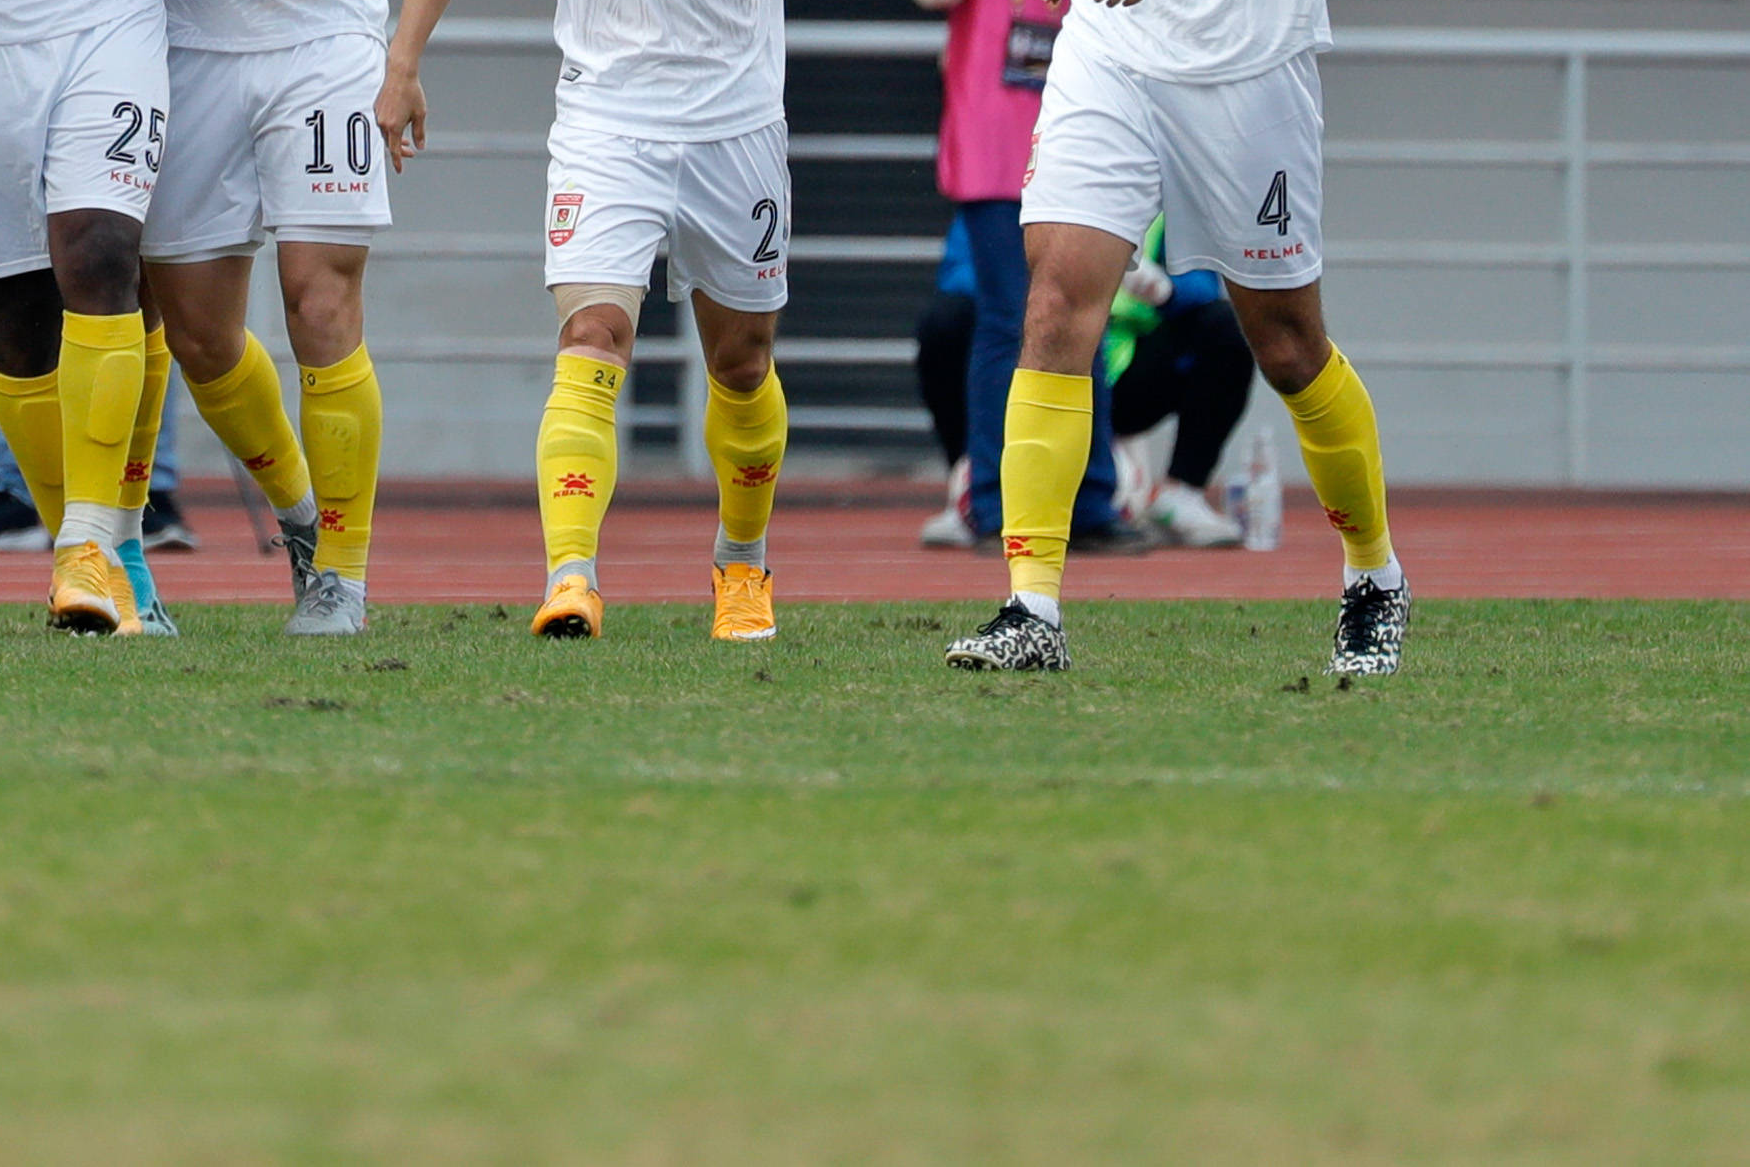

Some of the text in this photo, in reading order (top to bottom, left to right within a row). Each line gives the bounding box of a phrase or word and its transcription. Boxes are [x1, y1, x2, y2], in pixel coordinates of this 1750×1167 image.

[105, 101, 165, 173] 25
[304, 109, 372, 175] 10
[110, 170, 154, 192] KELM
[311, 182, 369, 193] KELME
[1257, 170, 1291, 236] 4
[752, 197, 786, 263] 2
[1243, 243, 1303, 260] KELME
[594, 370, 616, 389] 24
